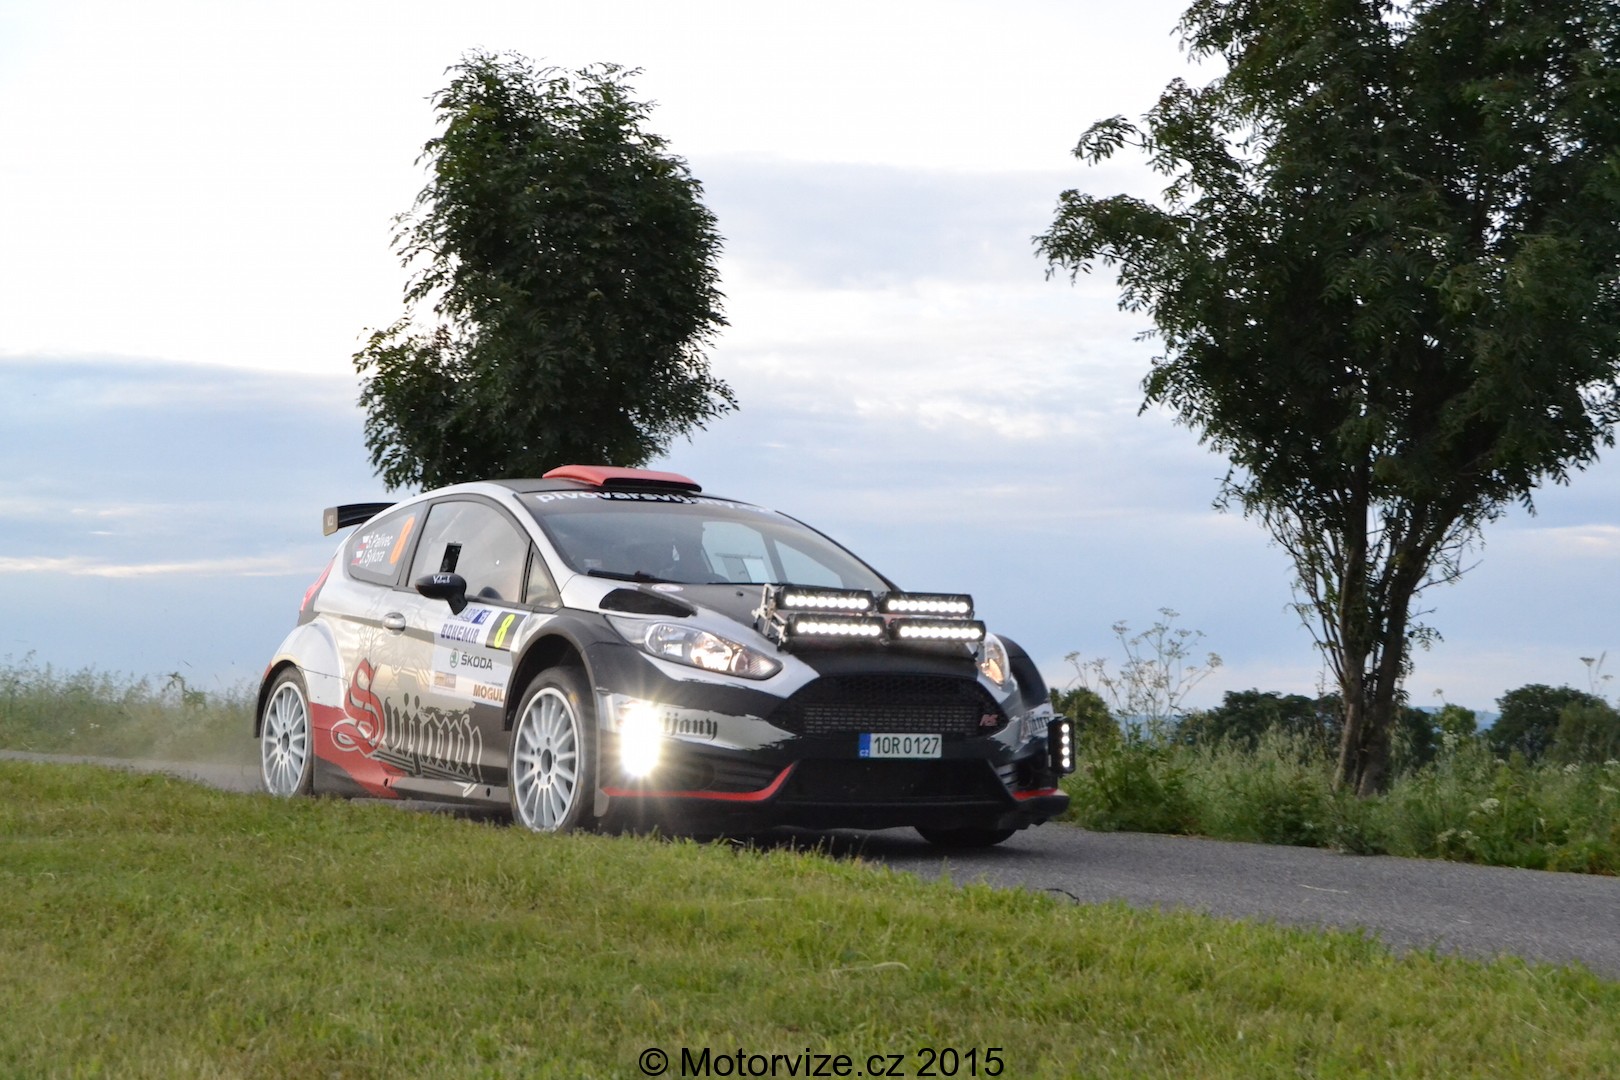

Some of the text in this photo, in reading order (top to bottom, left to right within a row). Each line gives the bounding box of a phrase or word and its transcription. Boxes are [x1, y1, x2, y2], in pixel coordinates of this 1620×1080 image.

[389, 515, 415, 566] 8
[494, 613, 516, 648] 8
[461, 652, 493, 670] ŠKODA
[473, 684, 504, 702] MOGUL
[874, 736, 940, 754] 10R 0127
